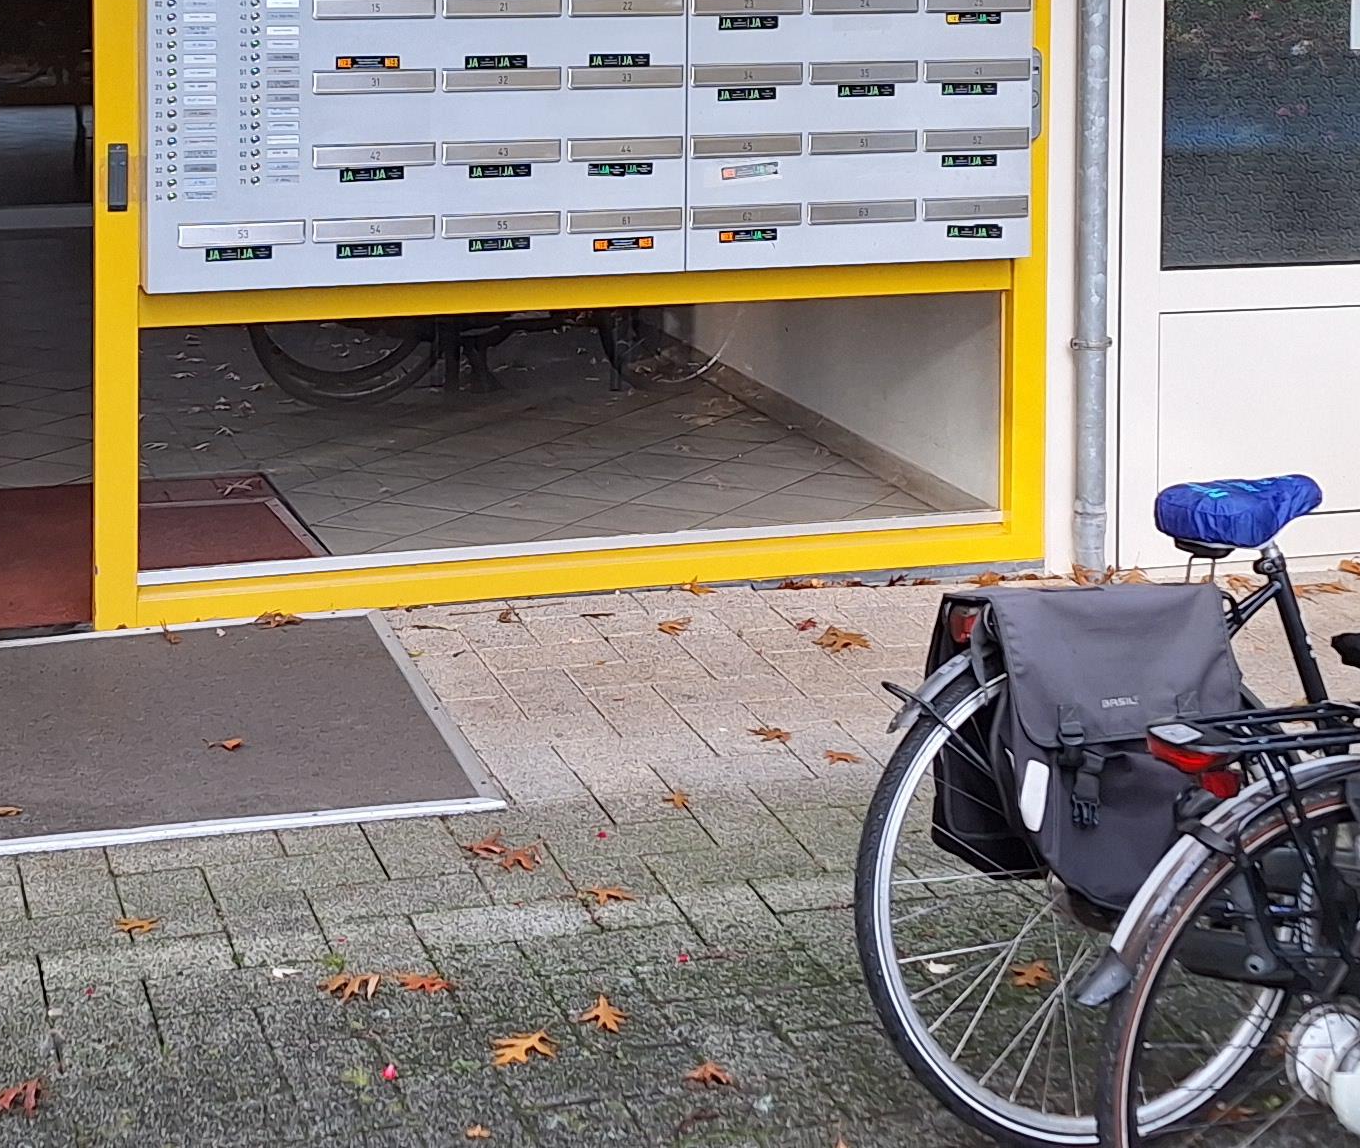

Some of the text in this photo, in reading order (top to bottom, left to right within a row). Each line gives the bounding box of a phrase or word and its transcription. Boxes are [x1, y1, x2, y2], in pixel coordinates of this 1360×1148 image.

[371, 3, 381, 12] 15
[499, 2, 508, 11] 21
[623, 1, 632, 10] 22
[744, 0, 754, 9] 23
[860, 0, 870, 8] 24
[721, 19, 732, 28] JA
[750, 18, 761, 27] JA
[467, 58, 478, 67] JA
[498, 57, 510, 67] JA
[591, 56, 602, 65] JA
[622, 56, 633, 65] JA
[622, 73, 632, 82] 33
[860, 69, 869, 78] 35
[371, 78, 380, 87] 31
[498, 75, 508, 84] 32
[840, 86, 851, 95] JA
[867, 86, 879, 95] JA
[943, 85, 954, 94] JA
[971, 84, 981, 93] JA
[719, 90, 730, 99] JA
[749, 89, 760, 98] JA
[860, 138, 868, 147] 51
[973, 136, 982, 145] 52
[621, 144, 631, 154] 44
[742, 142, 752, 151] 45
[370, 151, 380, 160] 42
[498, 147, 509, 156] 43
[943, 157, 953, 165] JA
[970, 156, 981, 165] JA
[471, 167, 482, 176] JA
[502, 166, 513, 175] JA
[600, 165, 609, 174] JA
[628, 164, 637, 173] JA
[342, 171, 354, 181] JA
[374, 169, 385, 179] JA
[858, 207, 868, 217] 63
[497, 220, 508, 229] 55
[622, 216, 631, 225] 61
[370, 224, 380, 234] 54
[949, 227, 959, 236] JA
[976, 227, 987, 236] JA
[237, 229, 249, 239] 53
[753, 231, 762, 240] JA
[471, 241, 482, 250] JA
[502, 240, 513, 249] JA
[207, 250, 220, 260] JA
[241, 249, 254, 259] JA
[339, 247, 351, 256] JA
[371, 245, 384, 255] JA
[1101, 697, 1138, 709] BASIL
